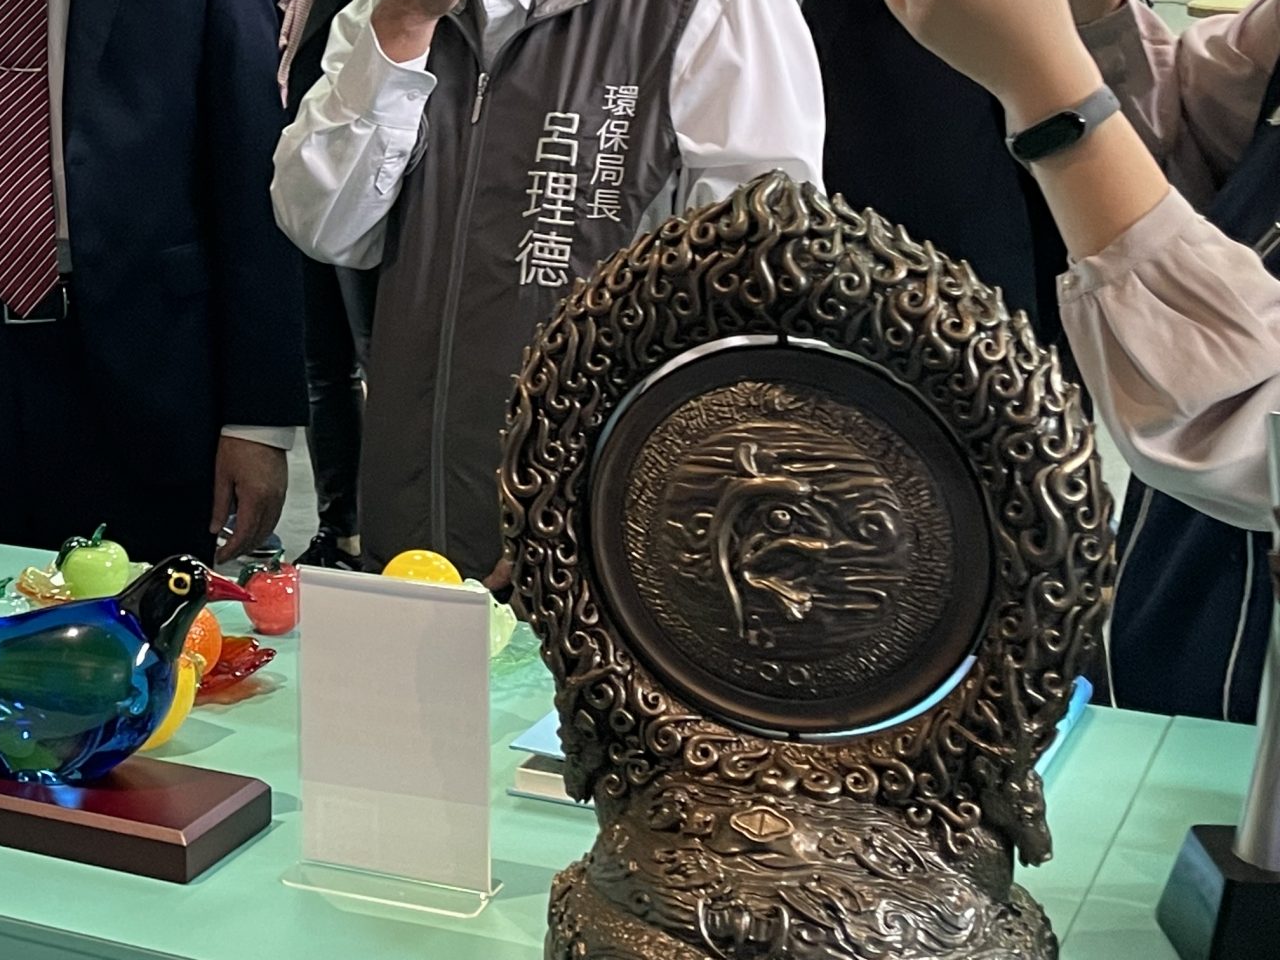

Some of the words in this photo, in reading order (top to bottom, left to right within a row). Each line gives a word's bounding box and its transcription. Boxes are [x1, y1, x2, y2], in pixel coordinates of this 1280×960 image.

[515, 112, 581, 288] 呂理德
[587, 84, 640, 223] 環保局長
